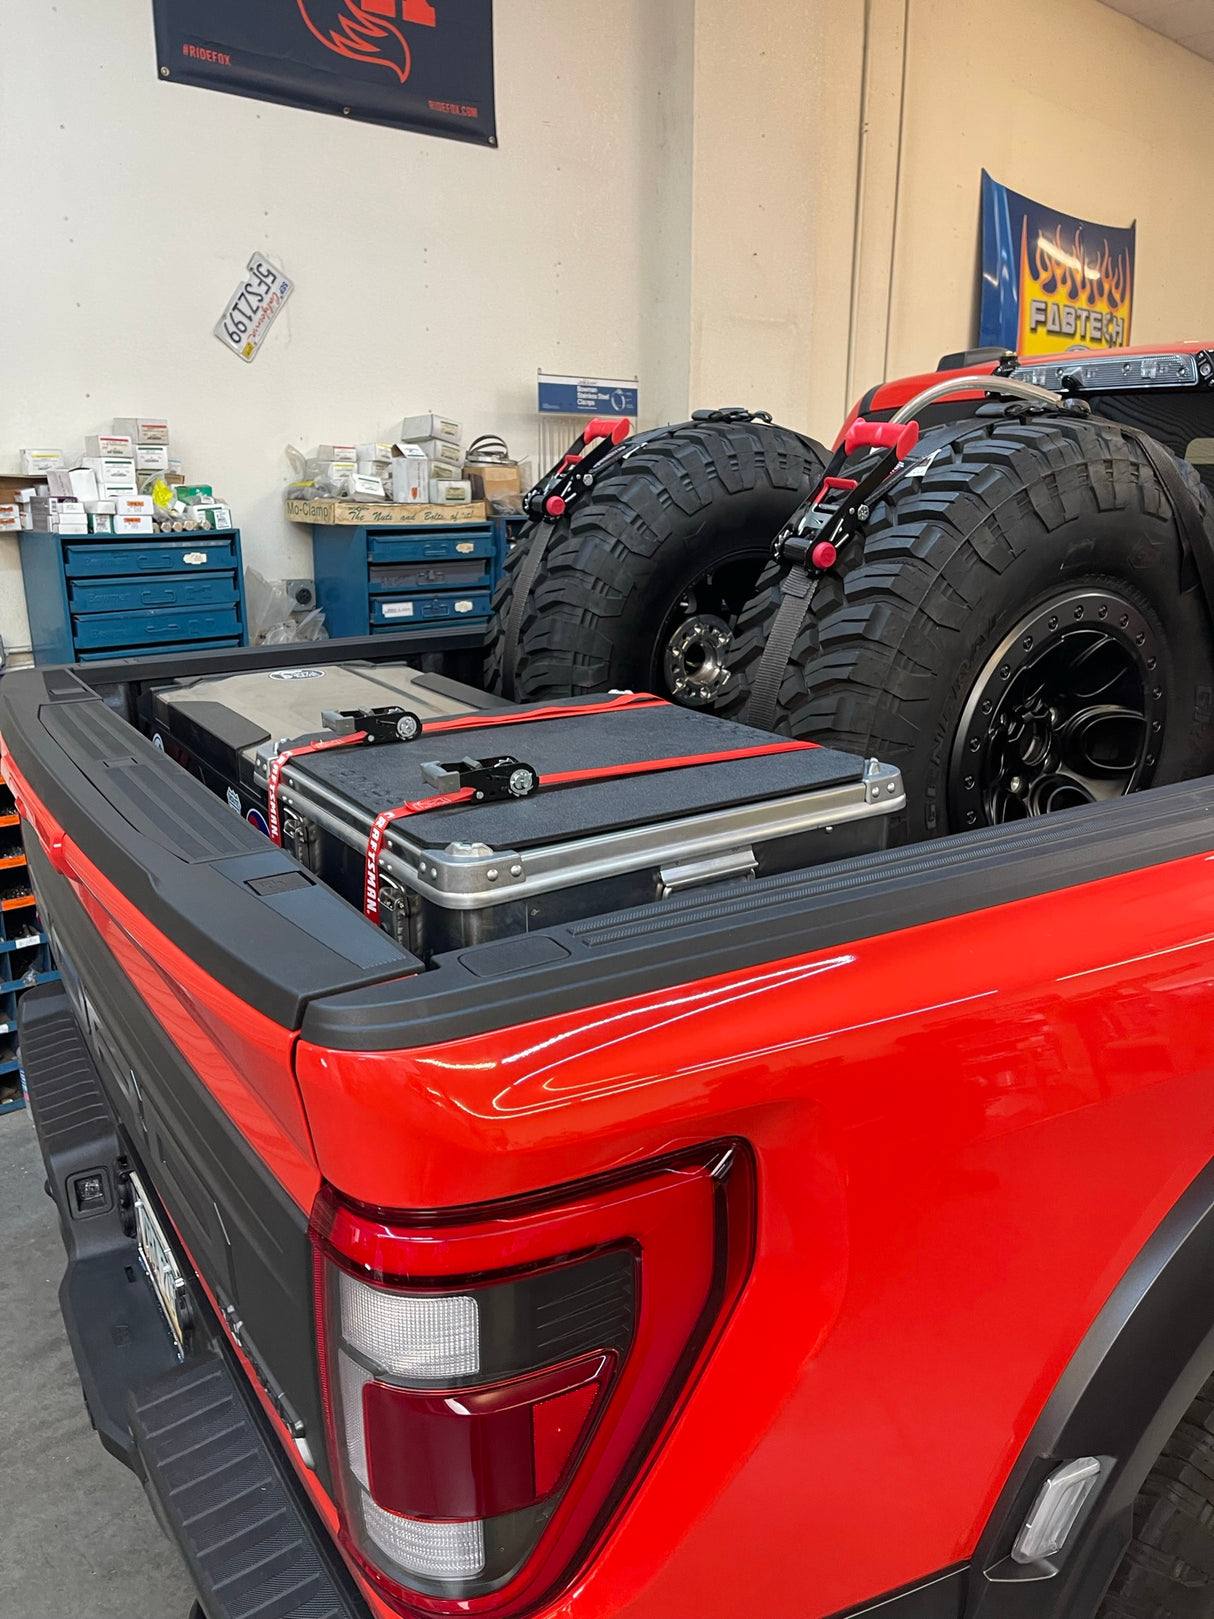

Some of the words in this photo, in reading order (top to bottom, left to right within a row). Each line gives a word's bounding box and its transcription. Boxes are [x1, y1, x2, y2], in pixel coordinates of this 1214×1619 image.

[183, 44, 231, 67] #RIDEFOX
[428, 101, 478, 118] RIDEFOX.COM
[224, 263, 276, 344] 5FSZ199
[1030, 300, 1124, 348] FABTECH
[287, 502, 329, 522] Mo-Clamp
[349, 511, 365, 520] The
[372, 512, 392, 521] Nuts
[400, 513, 417, 521] and
[424, 511, 443, 521] Bolts
[451, 512, 459, 522] of
[366, 811, 395, 912] CRAFTSMAN
